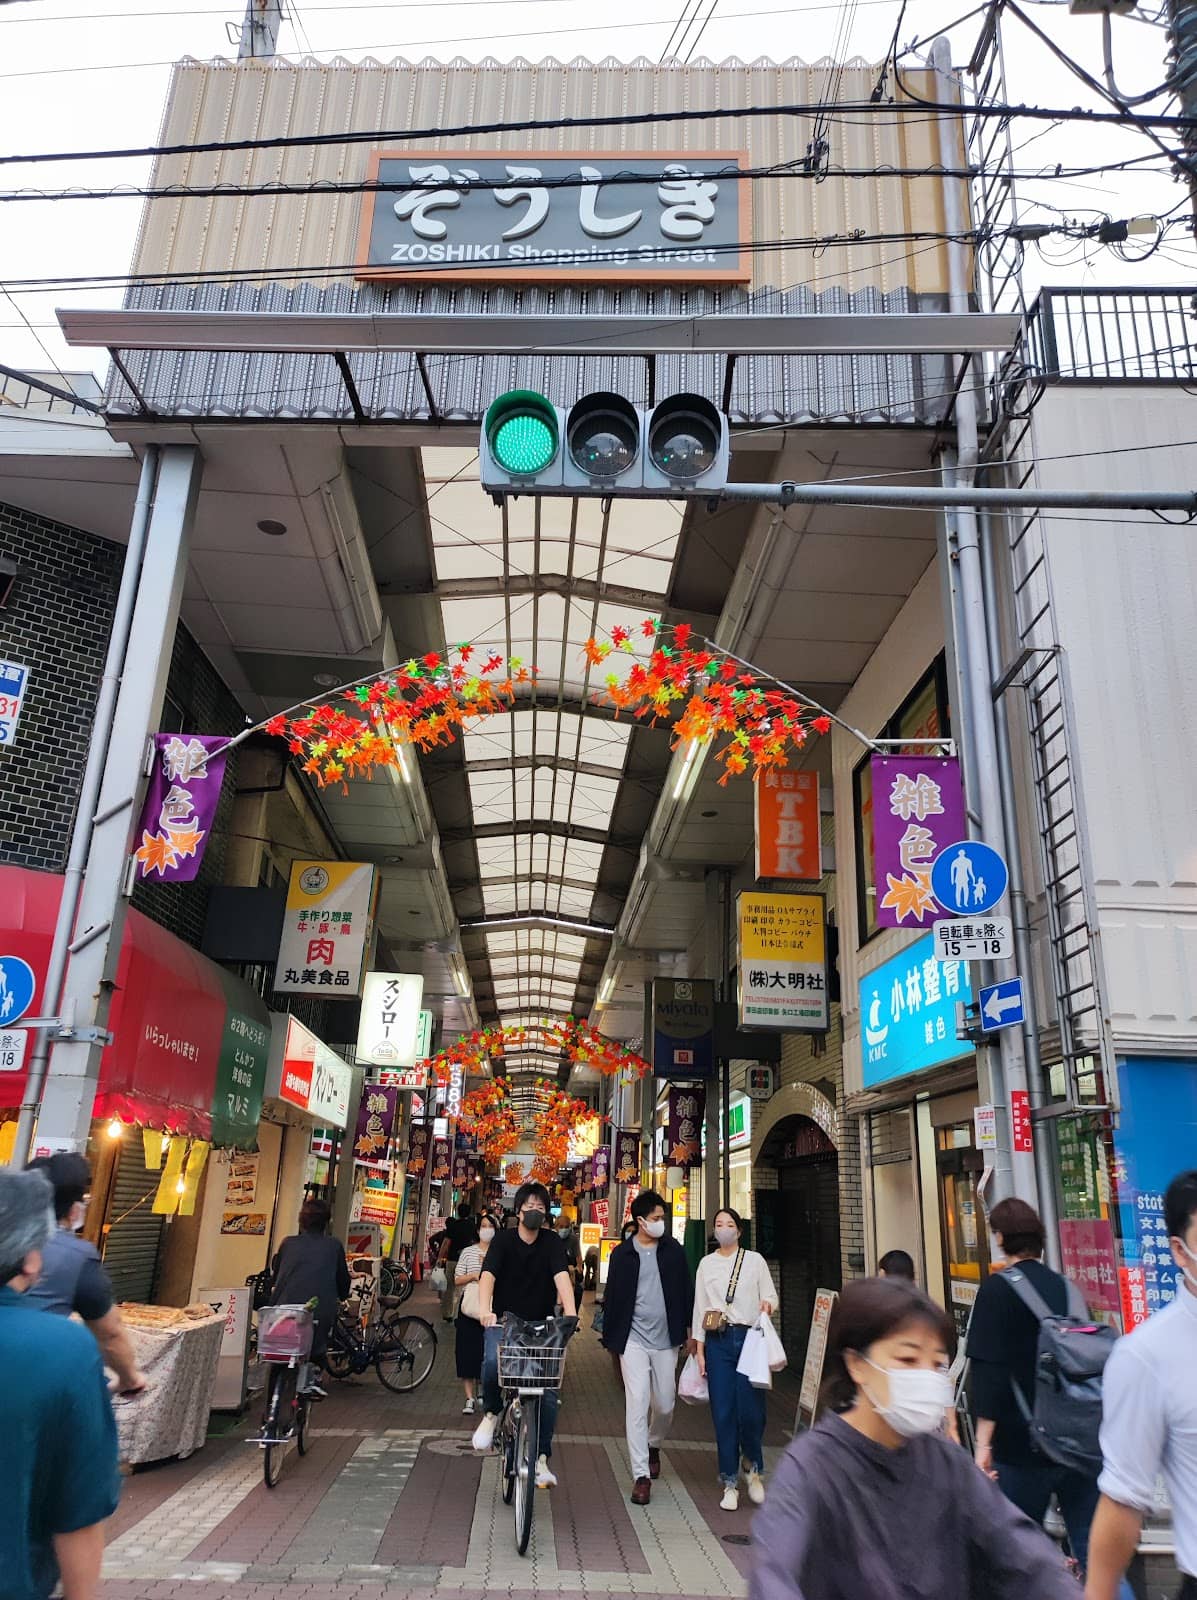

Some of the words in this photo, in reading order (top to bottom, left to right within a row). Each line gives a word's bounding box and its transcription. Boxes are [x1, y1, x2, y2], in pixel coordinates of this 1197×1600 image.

[393, 163, 718, 241] ぞうしき
[391, 243, 500, 262] ZOSHIKI
[508, 243, 628, 265] Shopping
[637, 243, 717, 263] Street
[159, 737, 210, 834] 雑色
[775, 791, 805, 875] TBK
[890, 773, 944, 875] 雑色
[299, 910, 353, 923] 手作り惣菜
[939, 922, 1005, 942] 自転車を除く
[306, 937, 335, 966] 肉
[283, 969, 350, 986] 丸美食品
[381, 978, 401, 1040] スシロー
[145, 1024, 200, 1062] いらっしゃいませ!
[235, 1048, 255, 1068] とんかつ
[868, 1042, 888, 1063] KMC
[366, 1092, 388, 1136] 雑色
[675, 1095, 699, 1141] 雑色
[1021, 1096, 1031, 1147] 送水口
[1140, 1216, 1168, 1230] 文具
[1143, 1253, 1172, 1266] 印章
[224, 1294, 237, 1335] とんかつ
